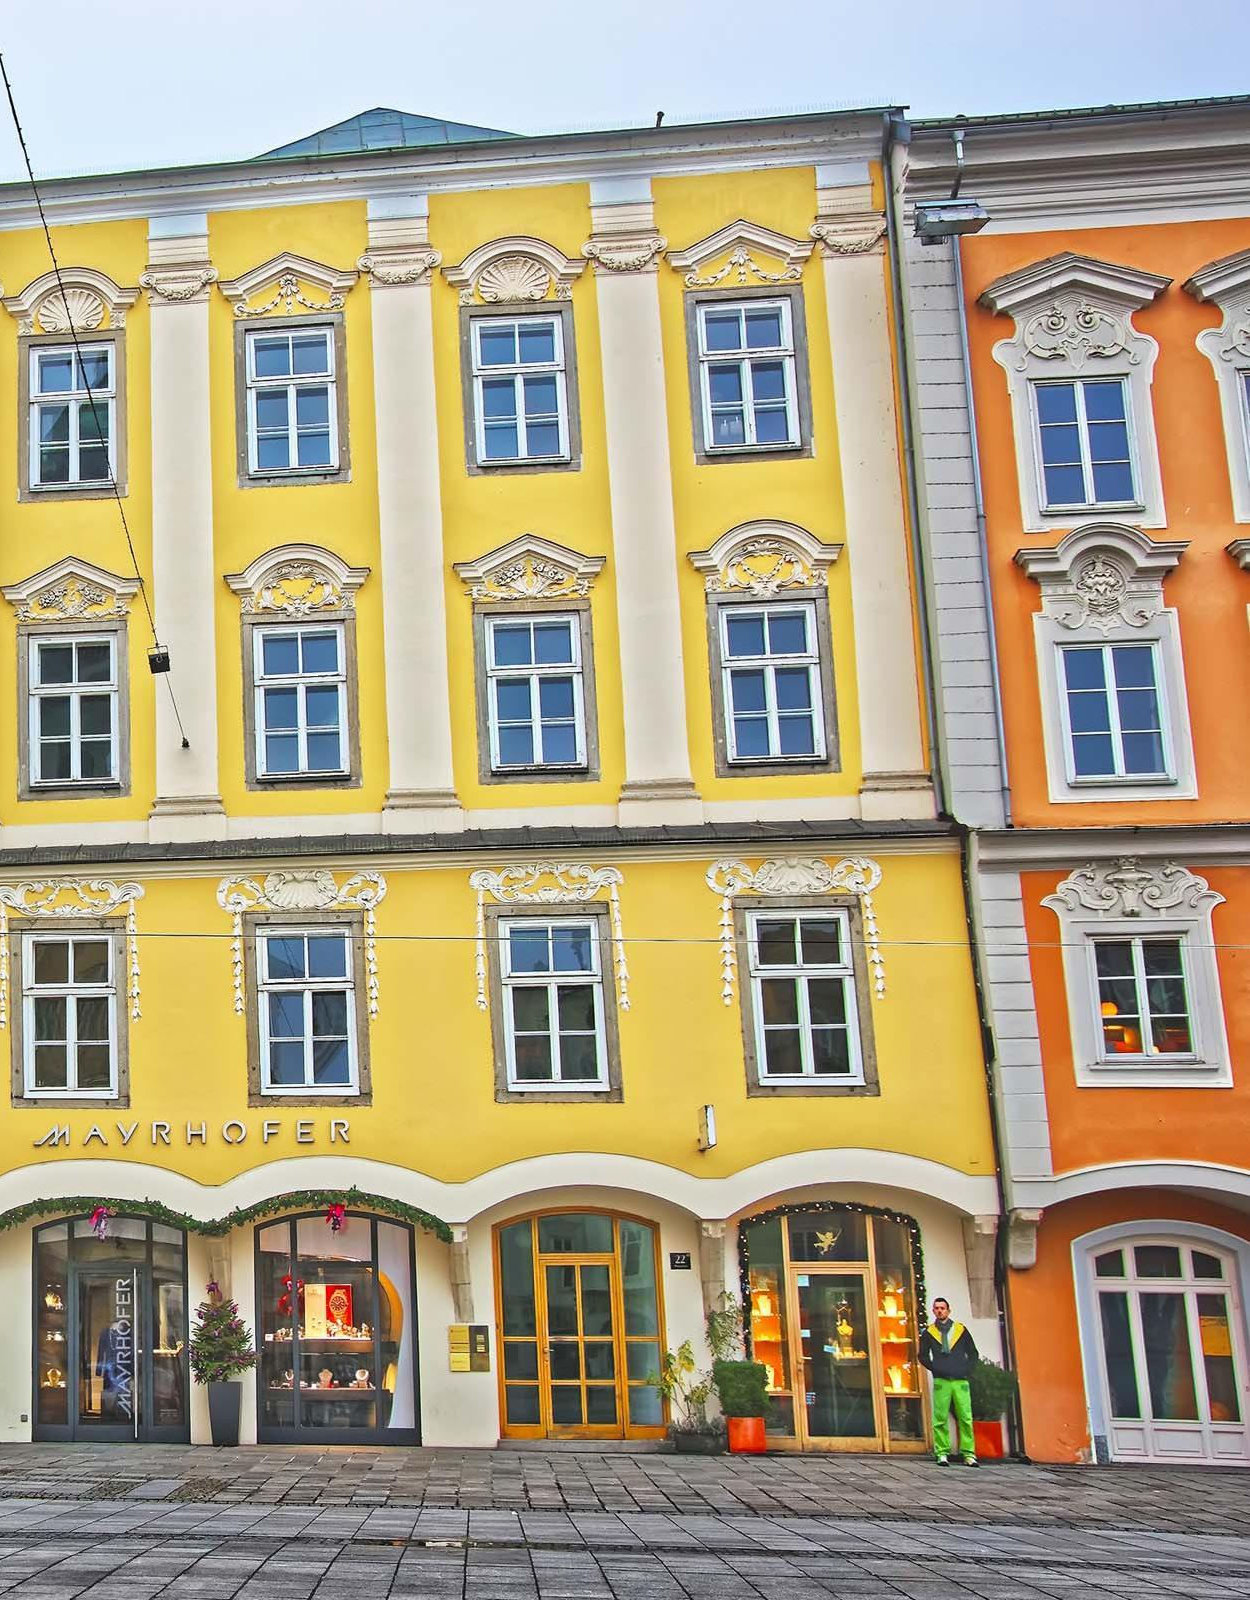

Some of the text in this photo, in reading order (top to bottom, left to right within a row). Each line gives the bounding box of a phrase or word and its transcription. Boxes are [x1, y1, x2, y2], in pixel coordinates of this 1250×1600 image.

[32, 1119, 351, 1147] MAYRHOFER
[675, 1255, 686, 1264] 22
[115, 1278, 132, 1419] MAYRHOFER
